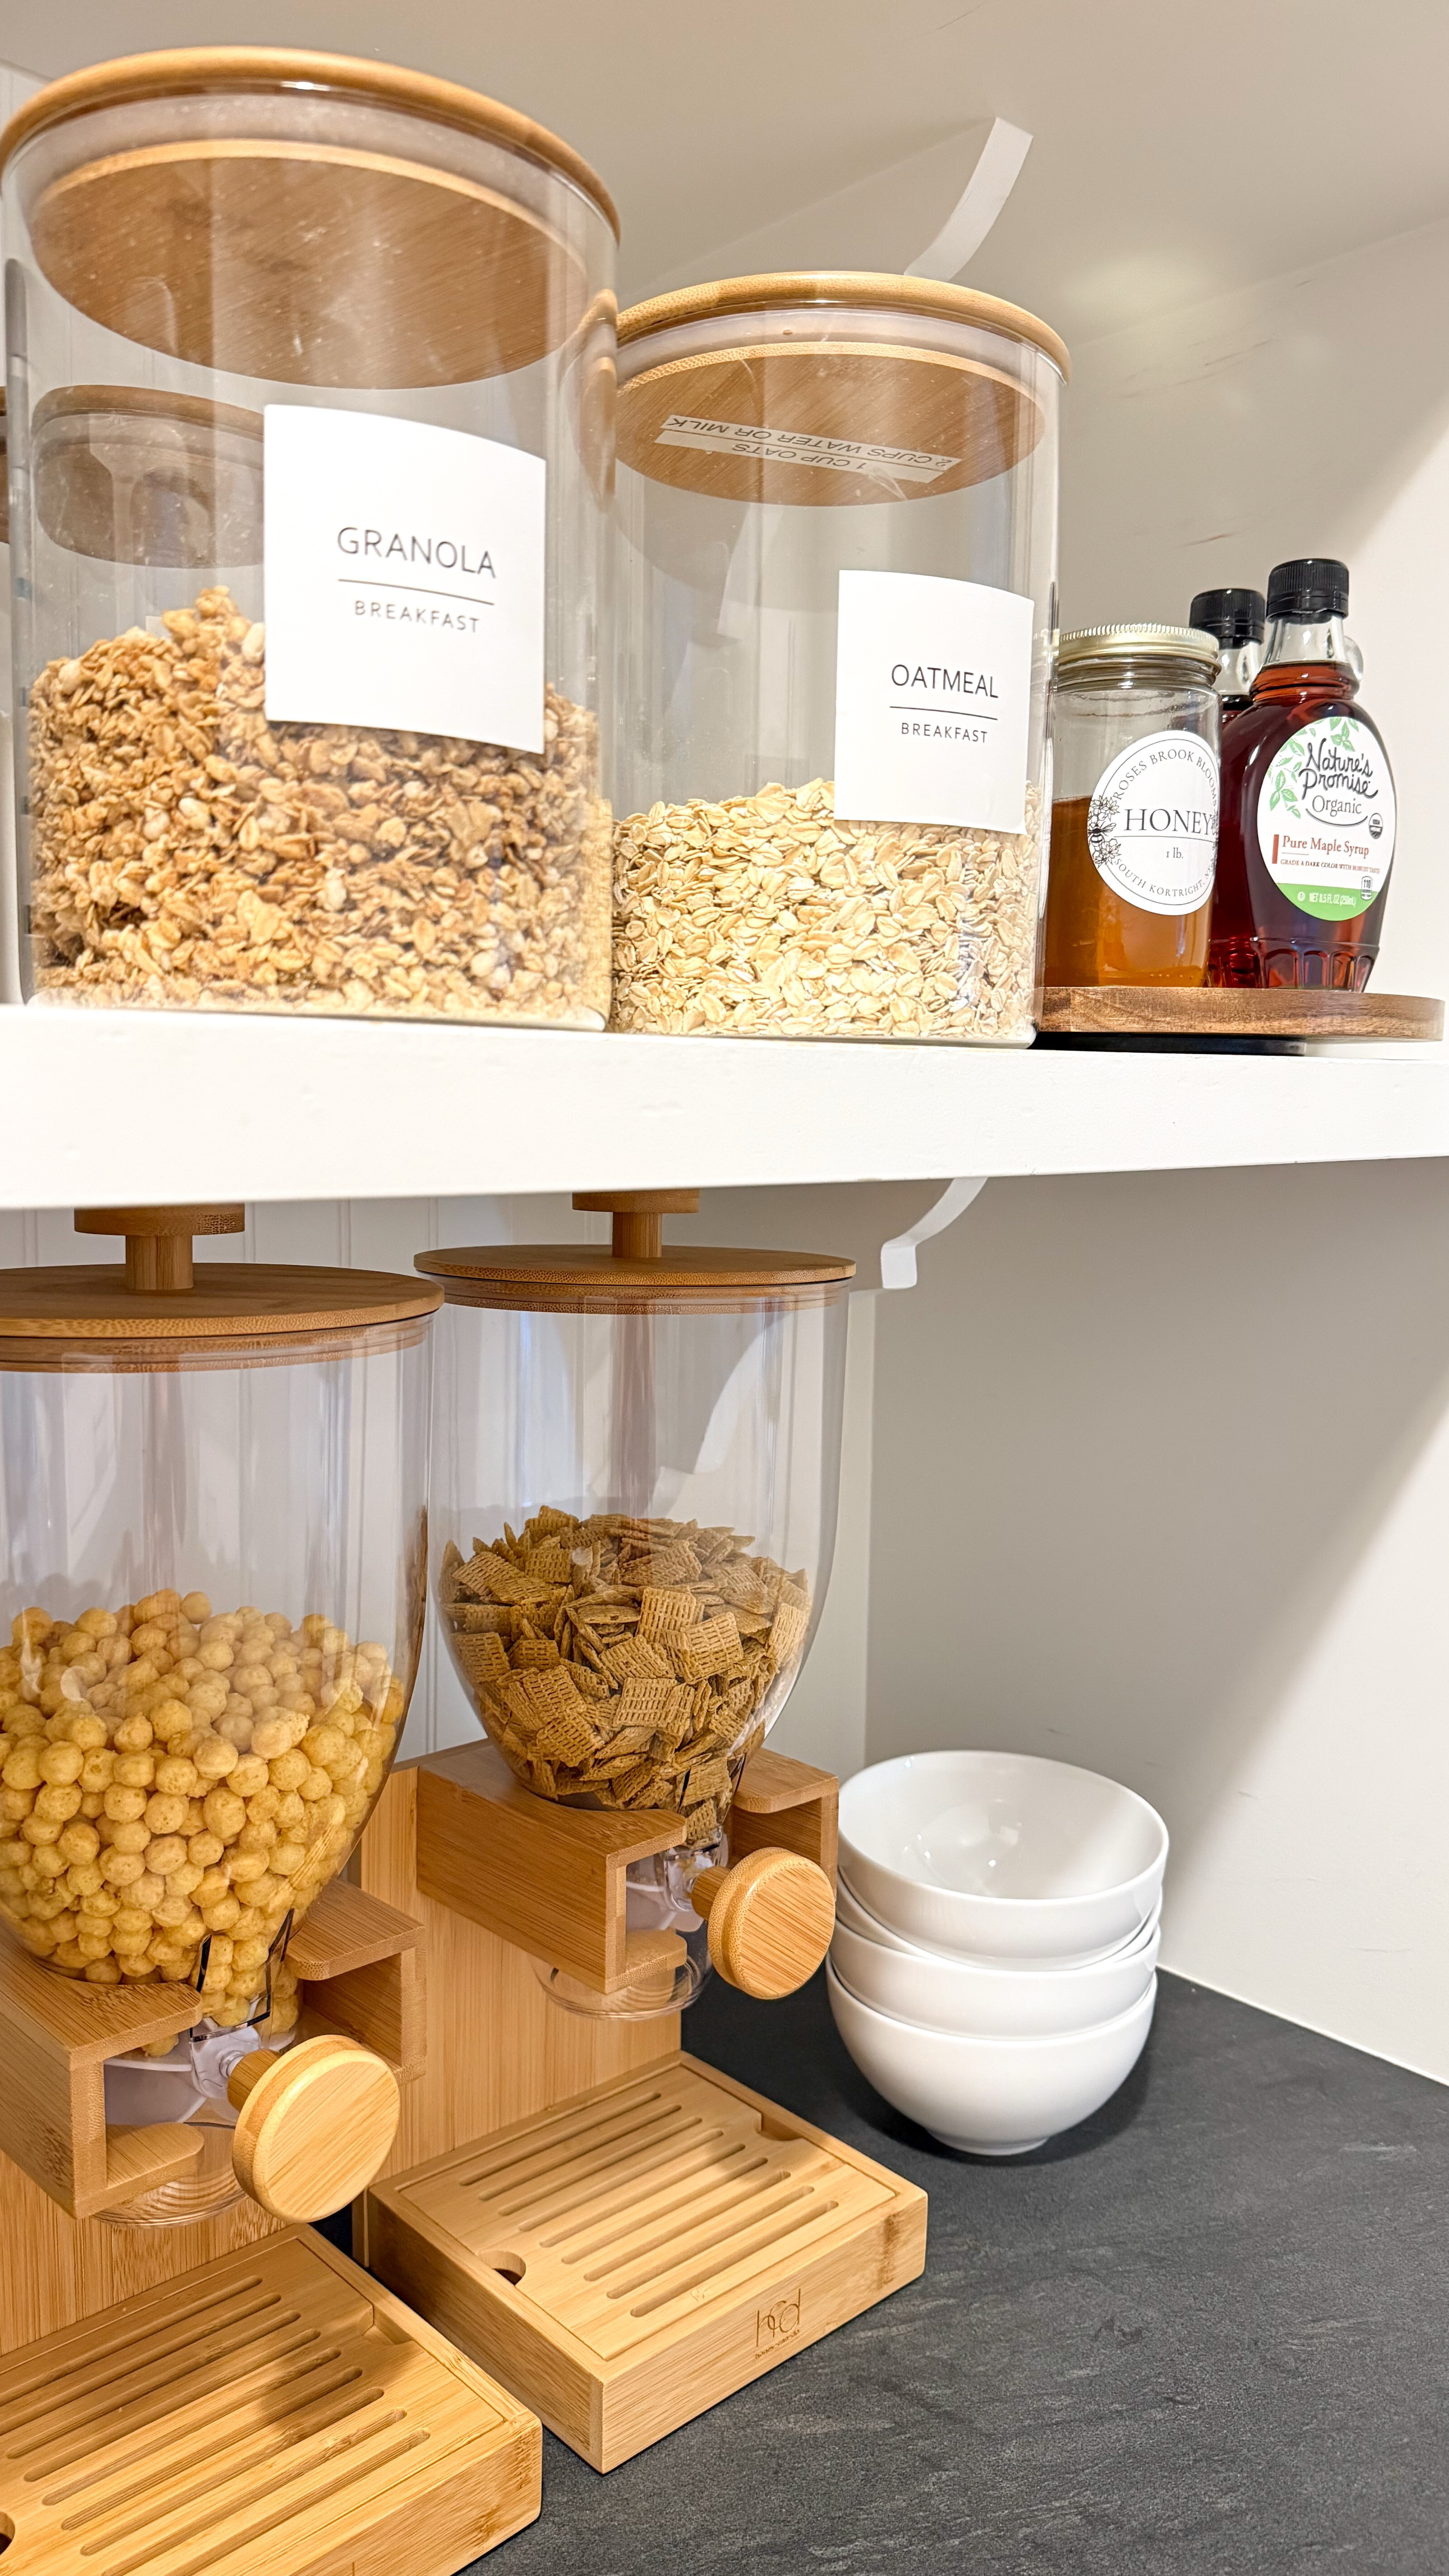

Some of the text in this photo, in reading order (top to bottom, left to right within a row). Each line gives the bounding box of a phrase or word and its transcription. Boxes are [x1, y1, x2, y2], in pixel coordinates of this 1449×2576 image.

[667, 418, 952, 467] 2 CUPS WATER OR MILK
[732, 444, 797, 458] OATS
[801, 456, 850, 467] CUP
[337, 527, 496, 579] GRANOLA
[354, 600, 480, 633] BREAKFAST
[891, 664, 999, 699] OATMEAL
[901, 722, 988, 743] BREAKFAST
[1306, 737, 1373, 778] Nature's
[1113, 760, 1147, 800] ROSES
[1149, 749, 1194, 765] BROOK
[1298, 768, 1379, 800] Promise
[1312, 795, 1362, 817] Organic
[1123, 808, 1212, 835] HONEY
[1173, 847, 1184, 859] lb.
[1282, 835, 1370, 859] Pure Maple Syrup
[1114, 858, 1146, 888] SOUTH
[1309, 892, 1319, 902] NET
